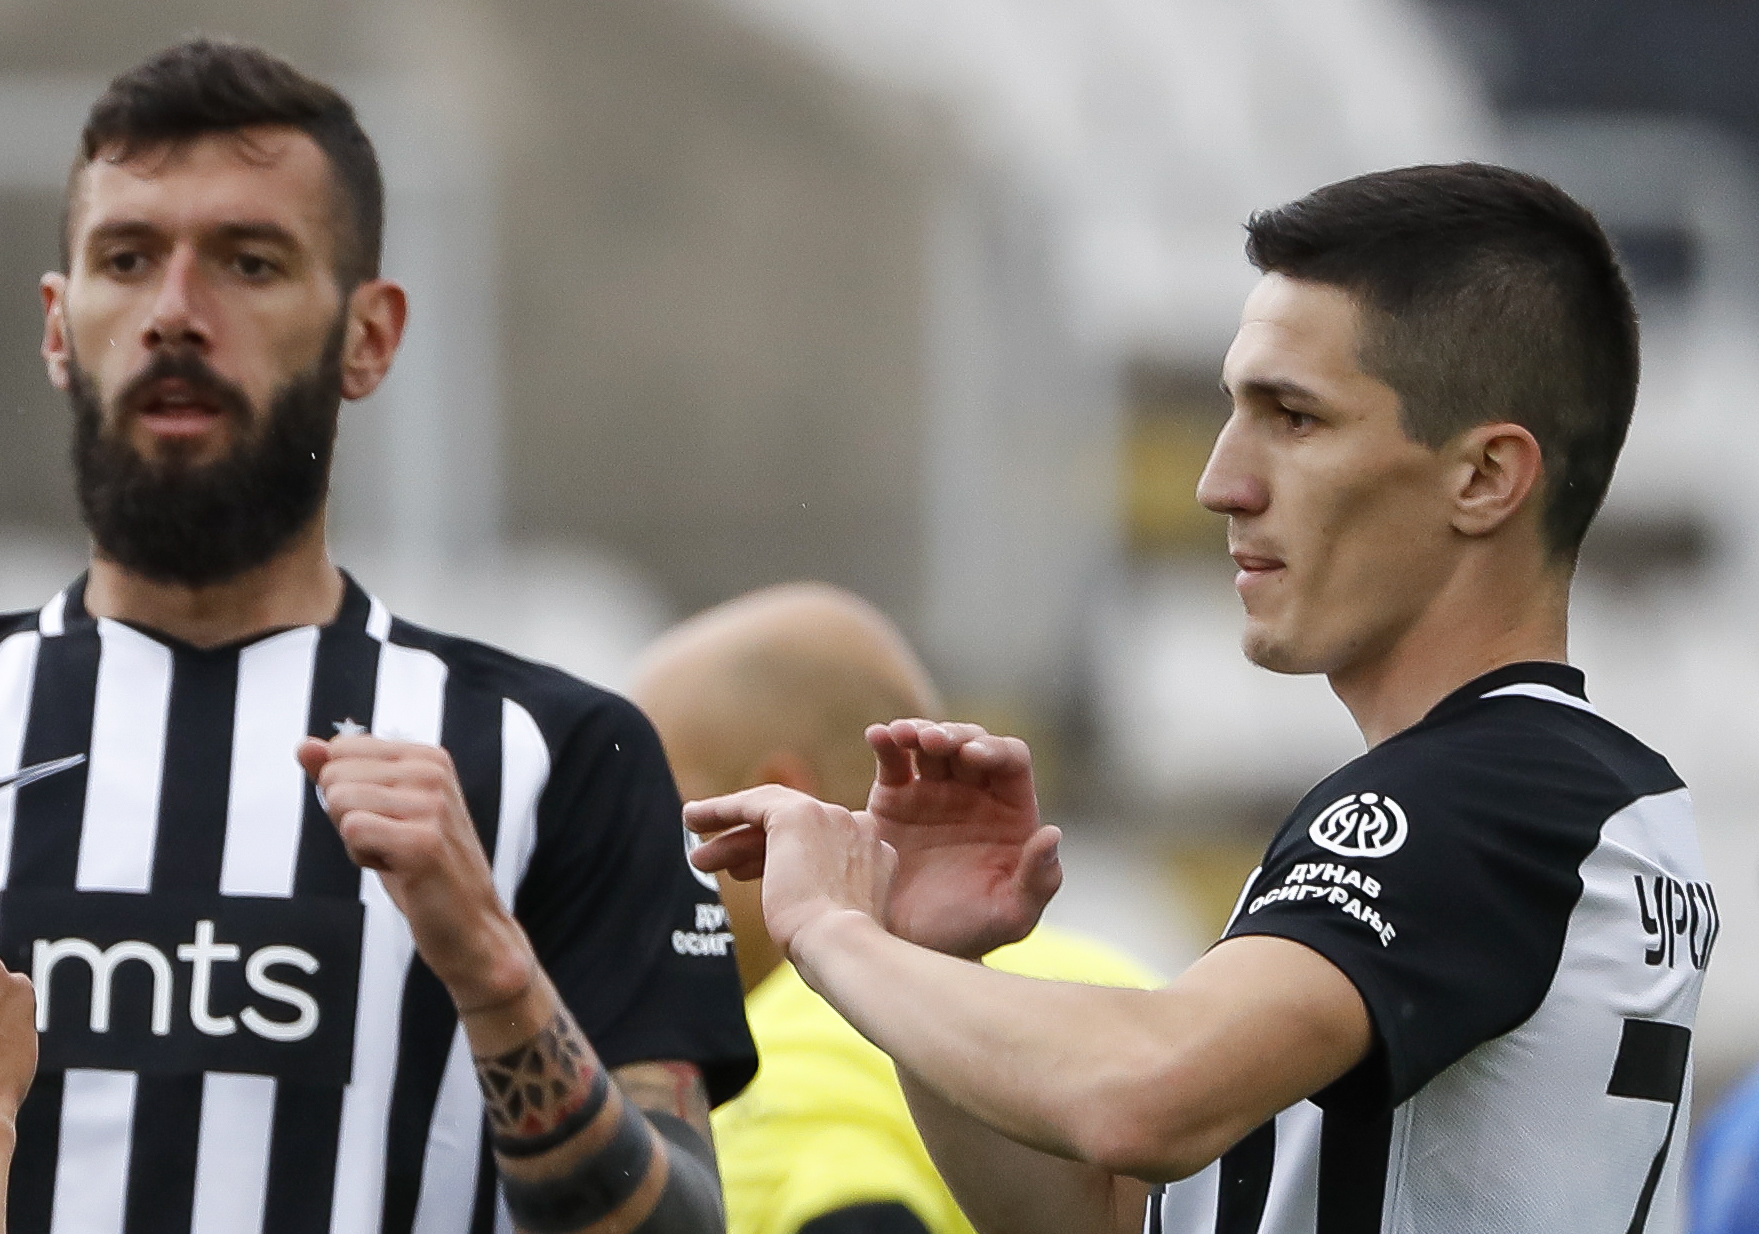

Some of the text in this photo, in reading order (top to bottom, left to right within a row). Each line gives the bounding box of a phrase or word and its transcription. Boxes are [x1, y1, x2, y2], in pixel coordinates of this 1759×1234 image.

[1285, 863, 1382, 898] ДУНАВ
[1248, 885, 1396, 947] ОСИГУРАЊЕ
[32, 919, 321, 1042] mts
